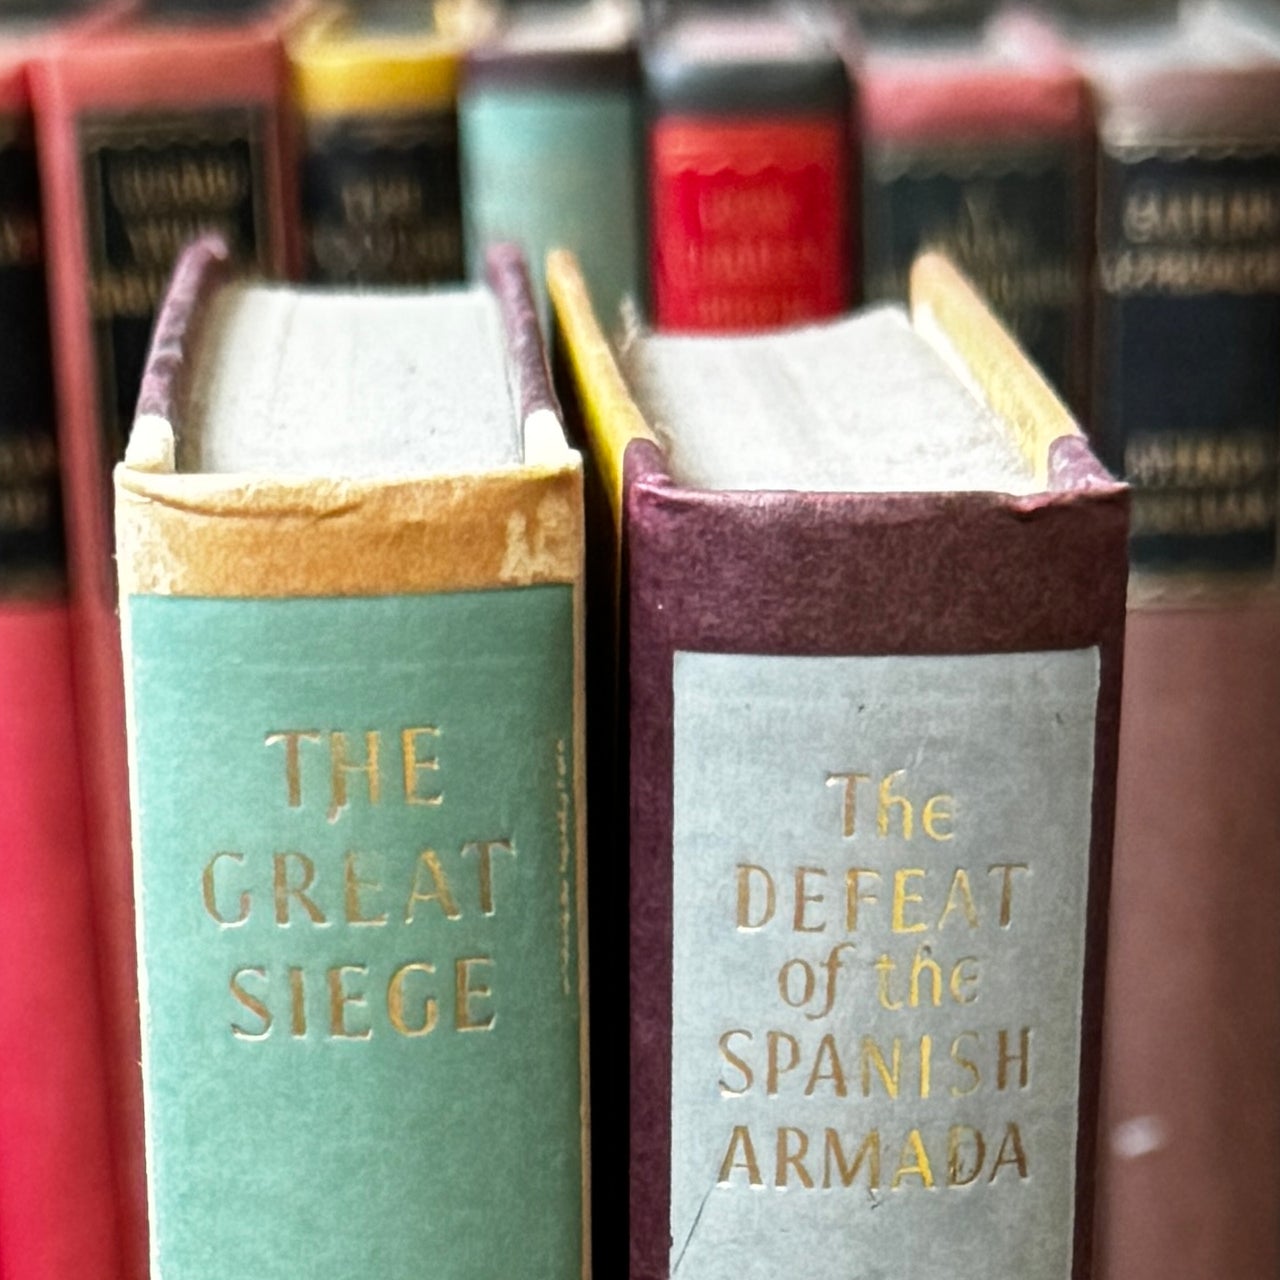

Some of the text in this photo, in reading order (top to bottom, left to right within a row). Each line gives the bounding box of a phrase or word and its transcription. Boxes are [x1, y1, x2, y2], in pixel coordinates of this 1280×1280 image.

[264, 726, 444, 824] THE
[825, 769, 957, 841] The
[201, 838, 517, 930] GREAT
[734, 862, 1034, 934] DEFEAT
[229, 955, 497, 1042] SIEGE
[778, 942, 980, 1020] of the
[718, 1027, 1032, 1100] SPANISH
[716, 1121, 1031, 1192] ARMADA
